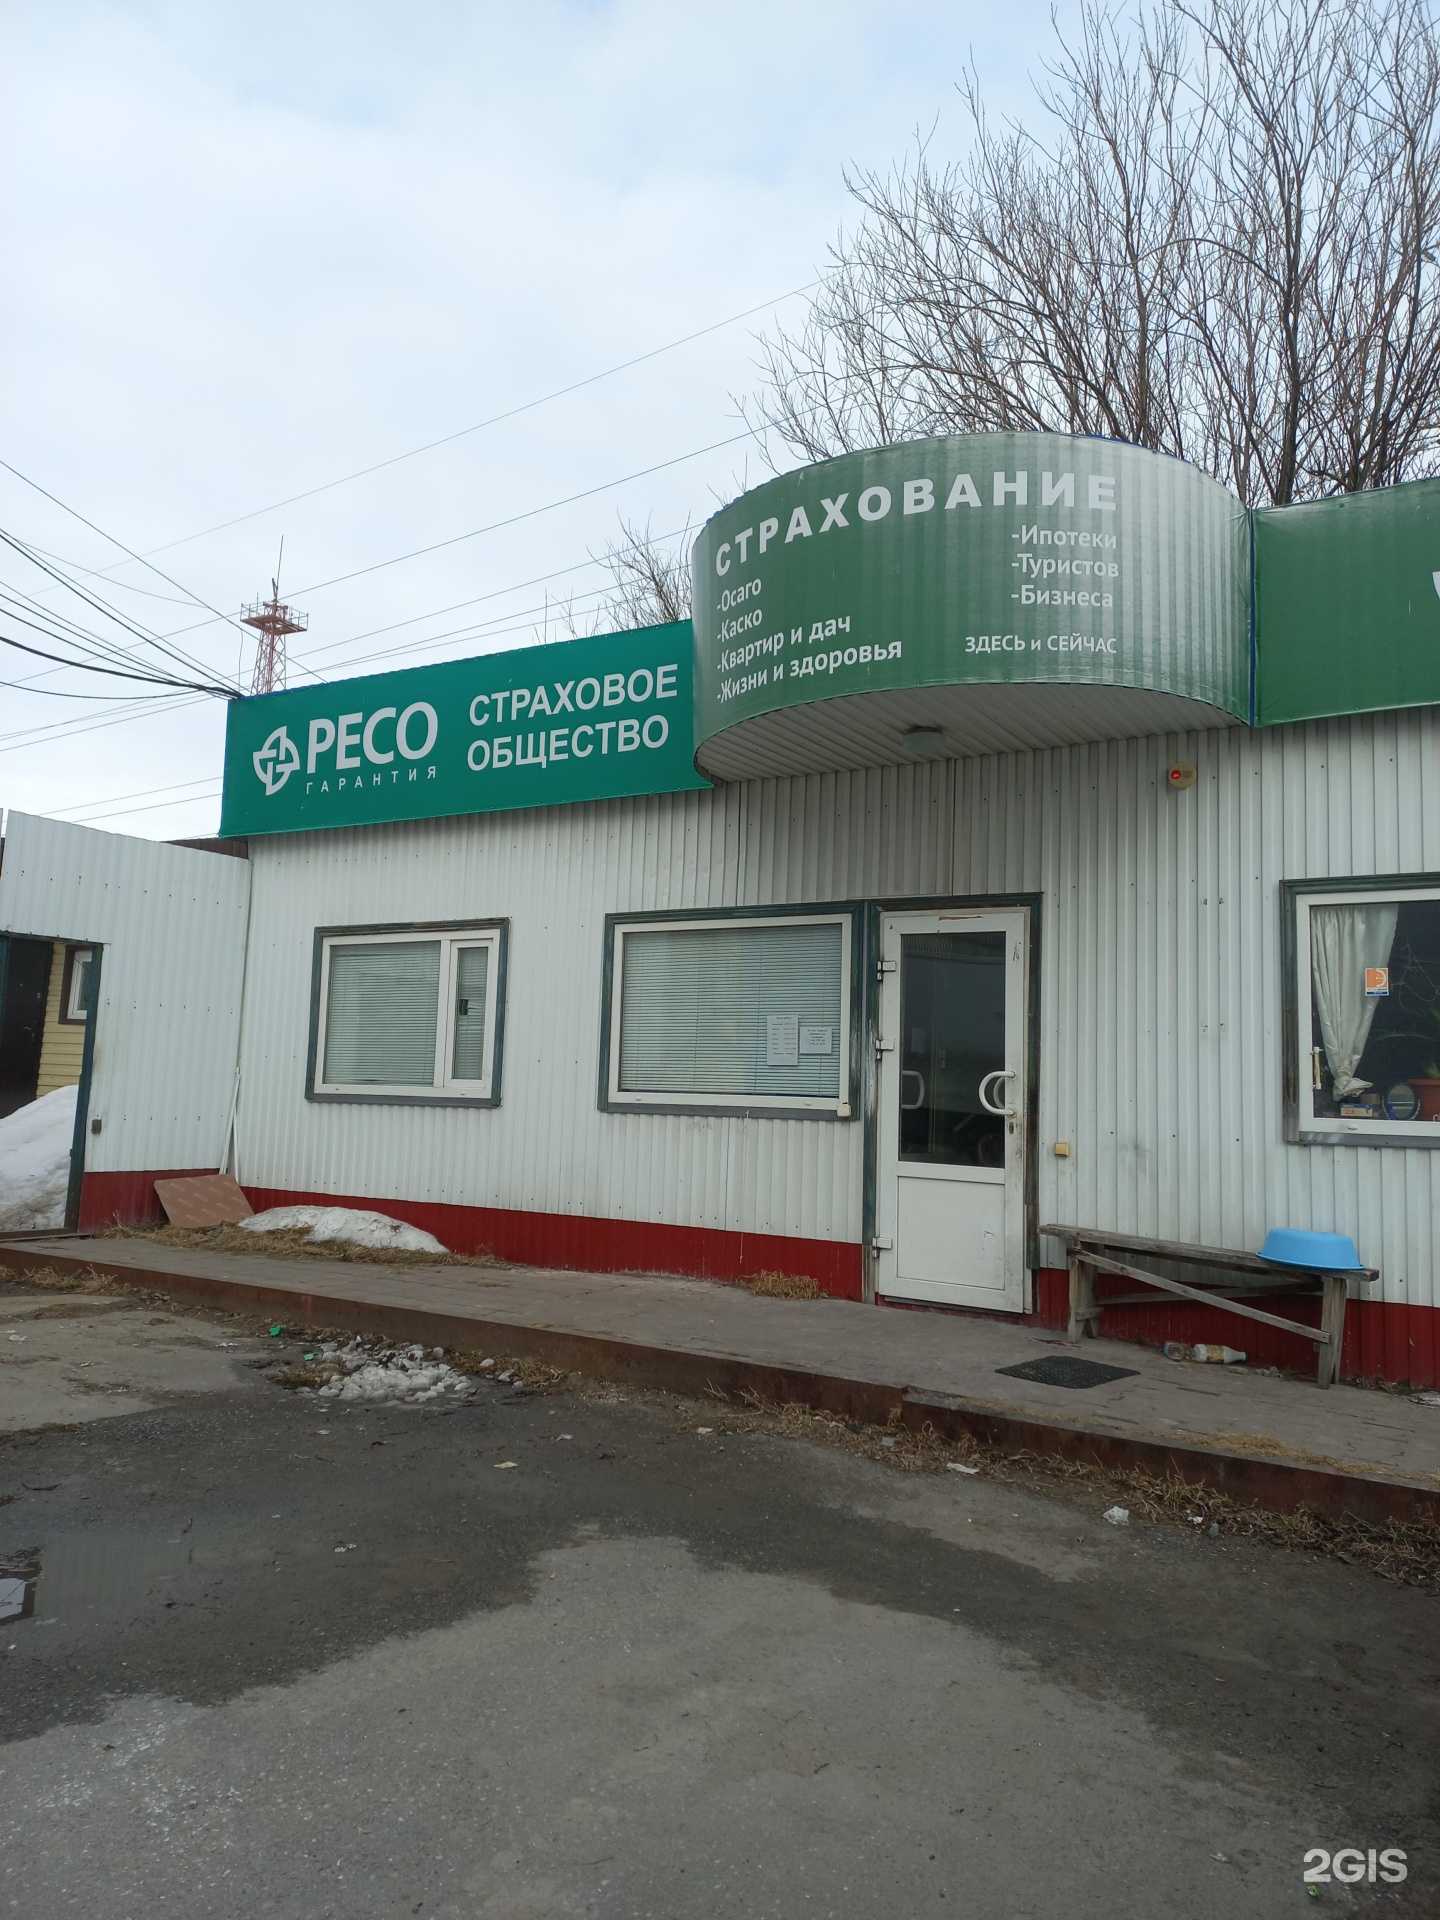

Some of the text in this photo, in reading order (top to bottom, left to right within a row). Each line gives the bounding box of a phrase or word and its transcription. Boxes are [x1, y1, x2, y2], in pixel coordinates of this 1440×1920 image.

[715, 471, 1117, 577] СТРАХОВАНИЕ
[1011, 525, 1117, 549] -Ипотеки
[1011, 553, 1119, 578] -Туристов
[716, 578, 762, 612] -Осаго
[1011, 584, 1113, 608] -Бизнеса
[716, 608, 763, 643] -Каско
[964, 632, 1117, 654] ЗДЕСЬ и СЕЙЧАС
[716, 615, 851, 673] -Квартир и дач
[716, 641, 902, 703] -Жизни и здоровья
[468, 663, 679, 726] СТРАХОВОЕ
[306, 701, 438, 774] РЕСО
[467, 715, 669, 772] ОБЩЕСТВО
[305, 766, 437, 795] ГАРАНТИЯ
